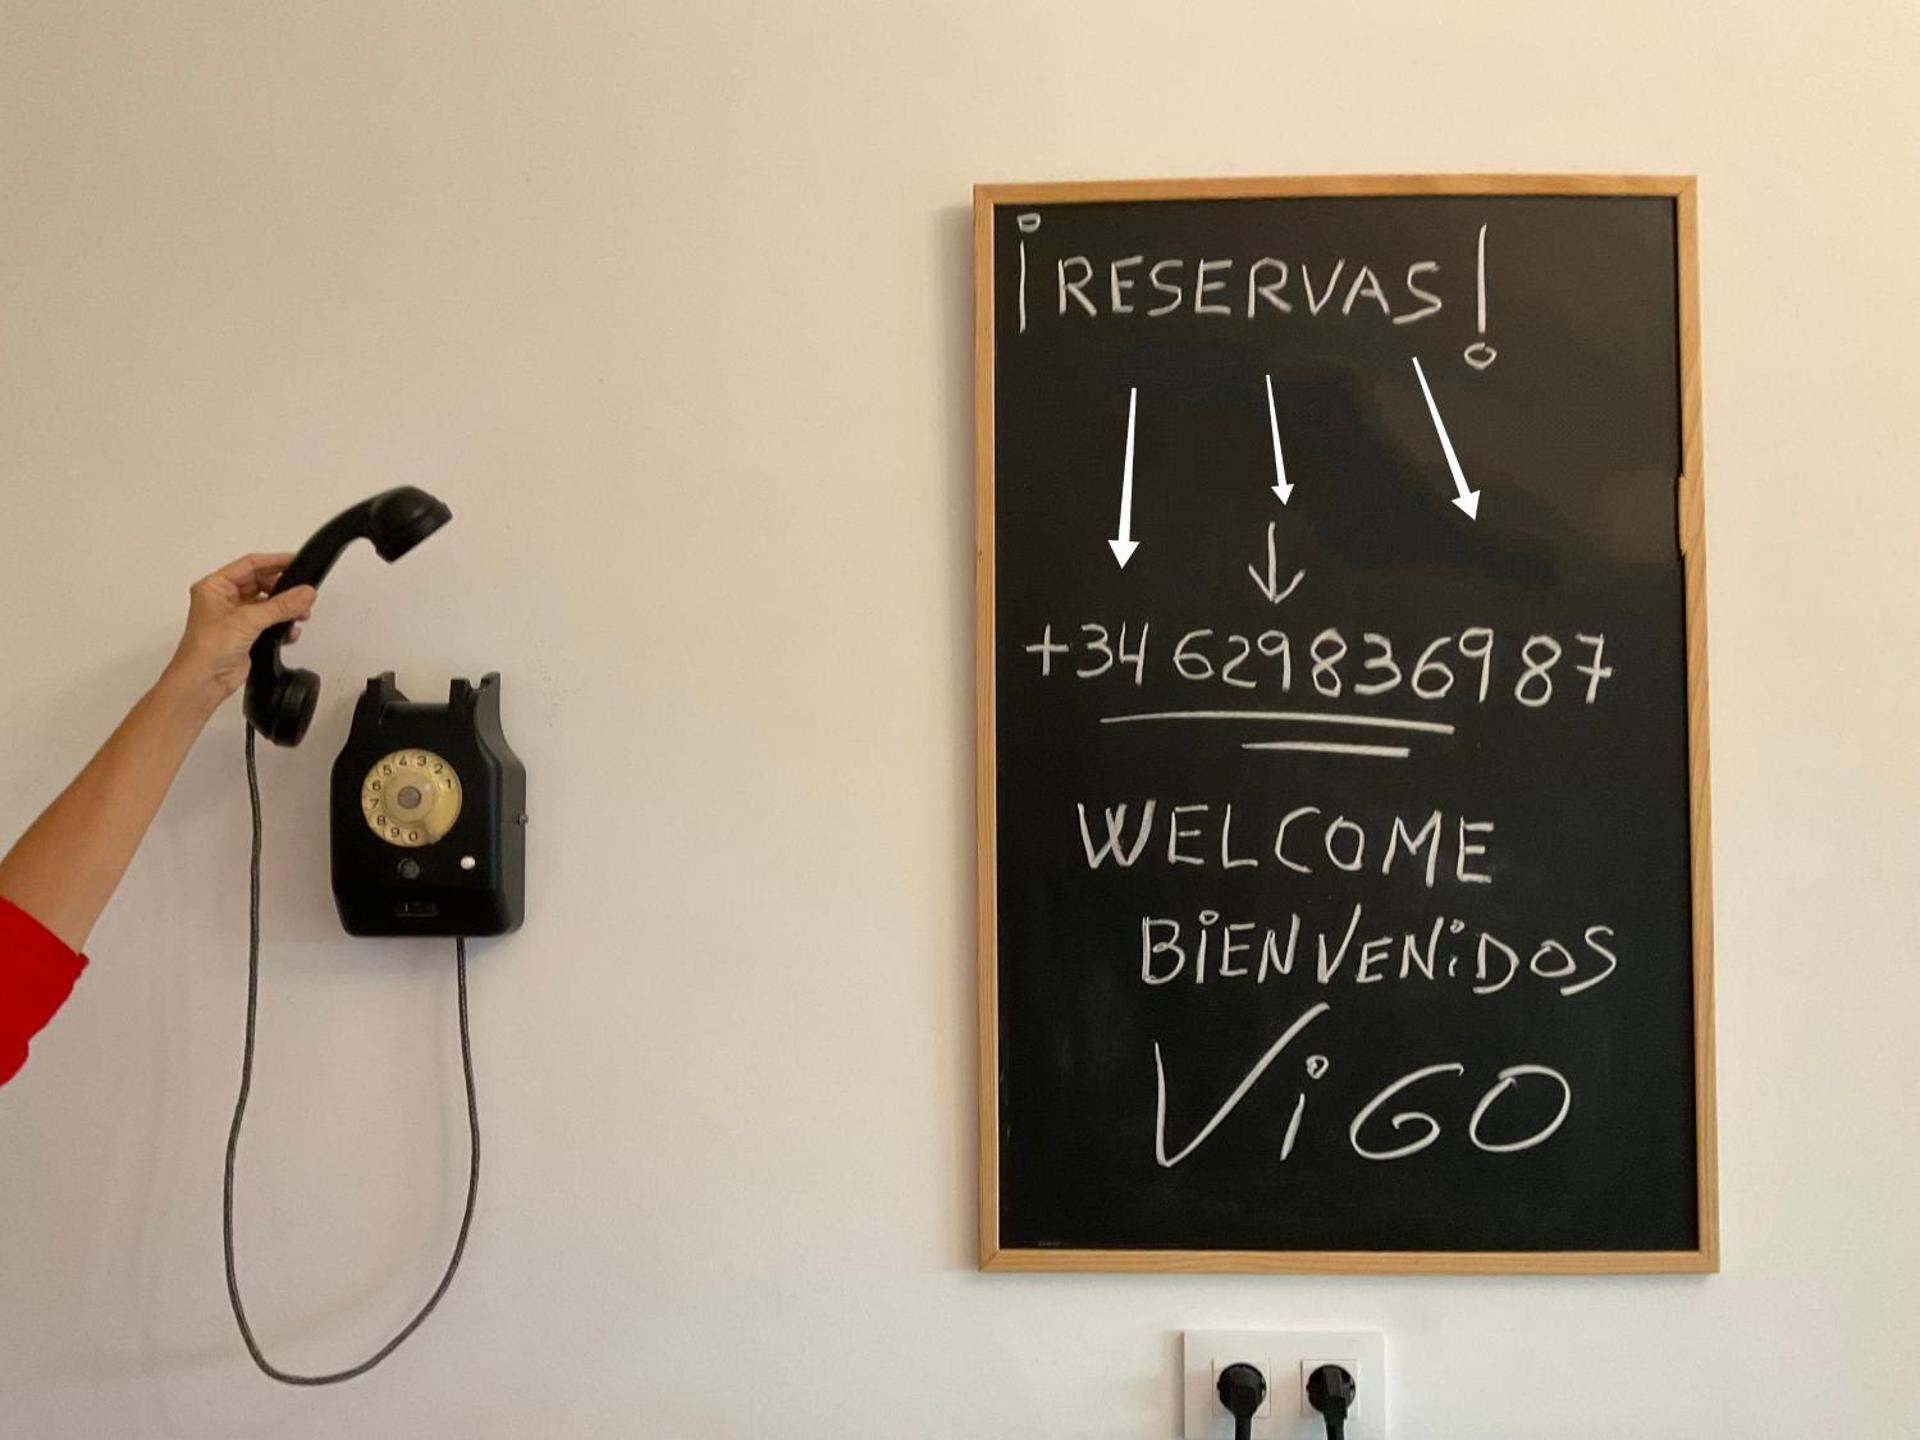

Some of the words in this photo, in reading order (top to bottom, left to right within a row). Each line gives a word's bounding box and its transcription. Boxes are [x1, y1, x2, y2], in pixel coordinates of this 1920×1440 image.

[1026, 622, 1149, 686] +34
[399, 755, 408, 767] 4
[417, 755, 426, 767] 3
[383, 764, 392, 776] 5
[433, 763, 443, 774] 2
[372, 780, 381, 791] 6
[370, 799, 380, 809] 7
[391, 827, 400, 838] 9
[408, 831, 418, 842] 0
[1078, 800, 1495, 887] WELCOME
